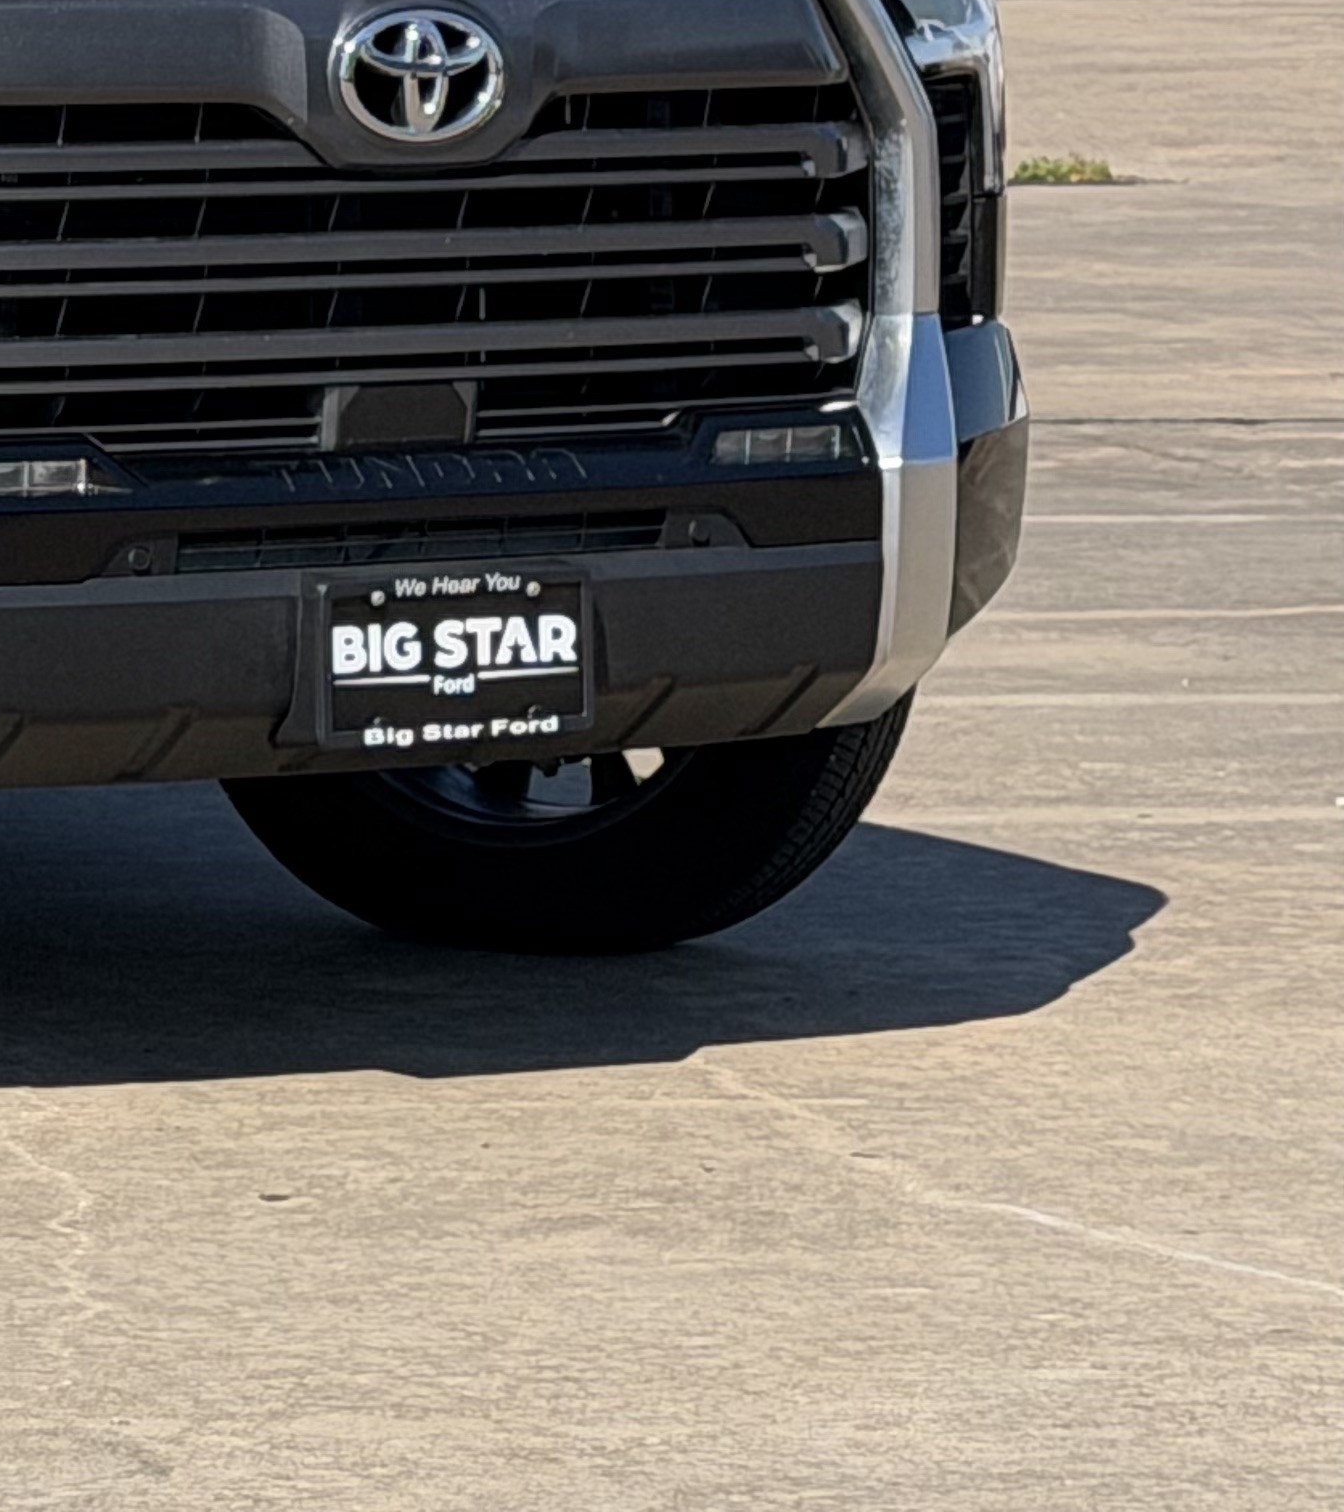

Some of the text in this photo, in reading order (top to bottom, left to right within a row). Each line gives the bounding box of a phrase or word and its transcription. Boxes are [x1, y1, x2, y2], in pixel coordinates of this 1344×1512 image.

[263, 446, 588, 492] TUNDRA
[395, 571, 521, 598] We Hear You
[331, 614, 578, 674] BIG STAR
[433, 674, 476, 696] Ford
[364, 715, 559, 747] Big Star Ford
